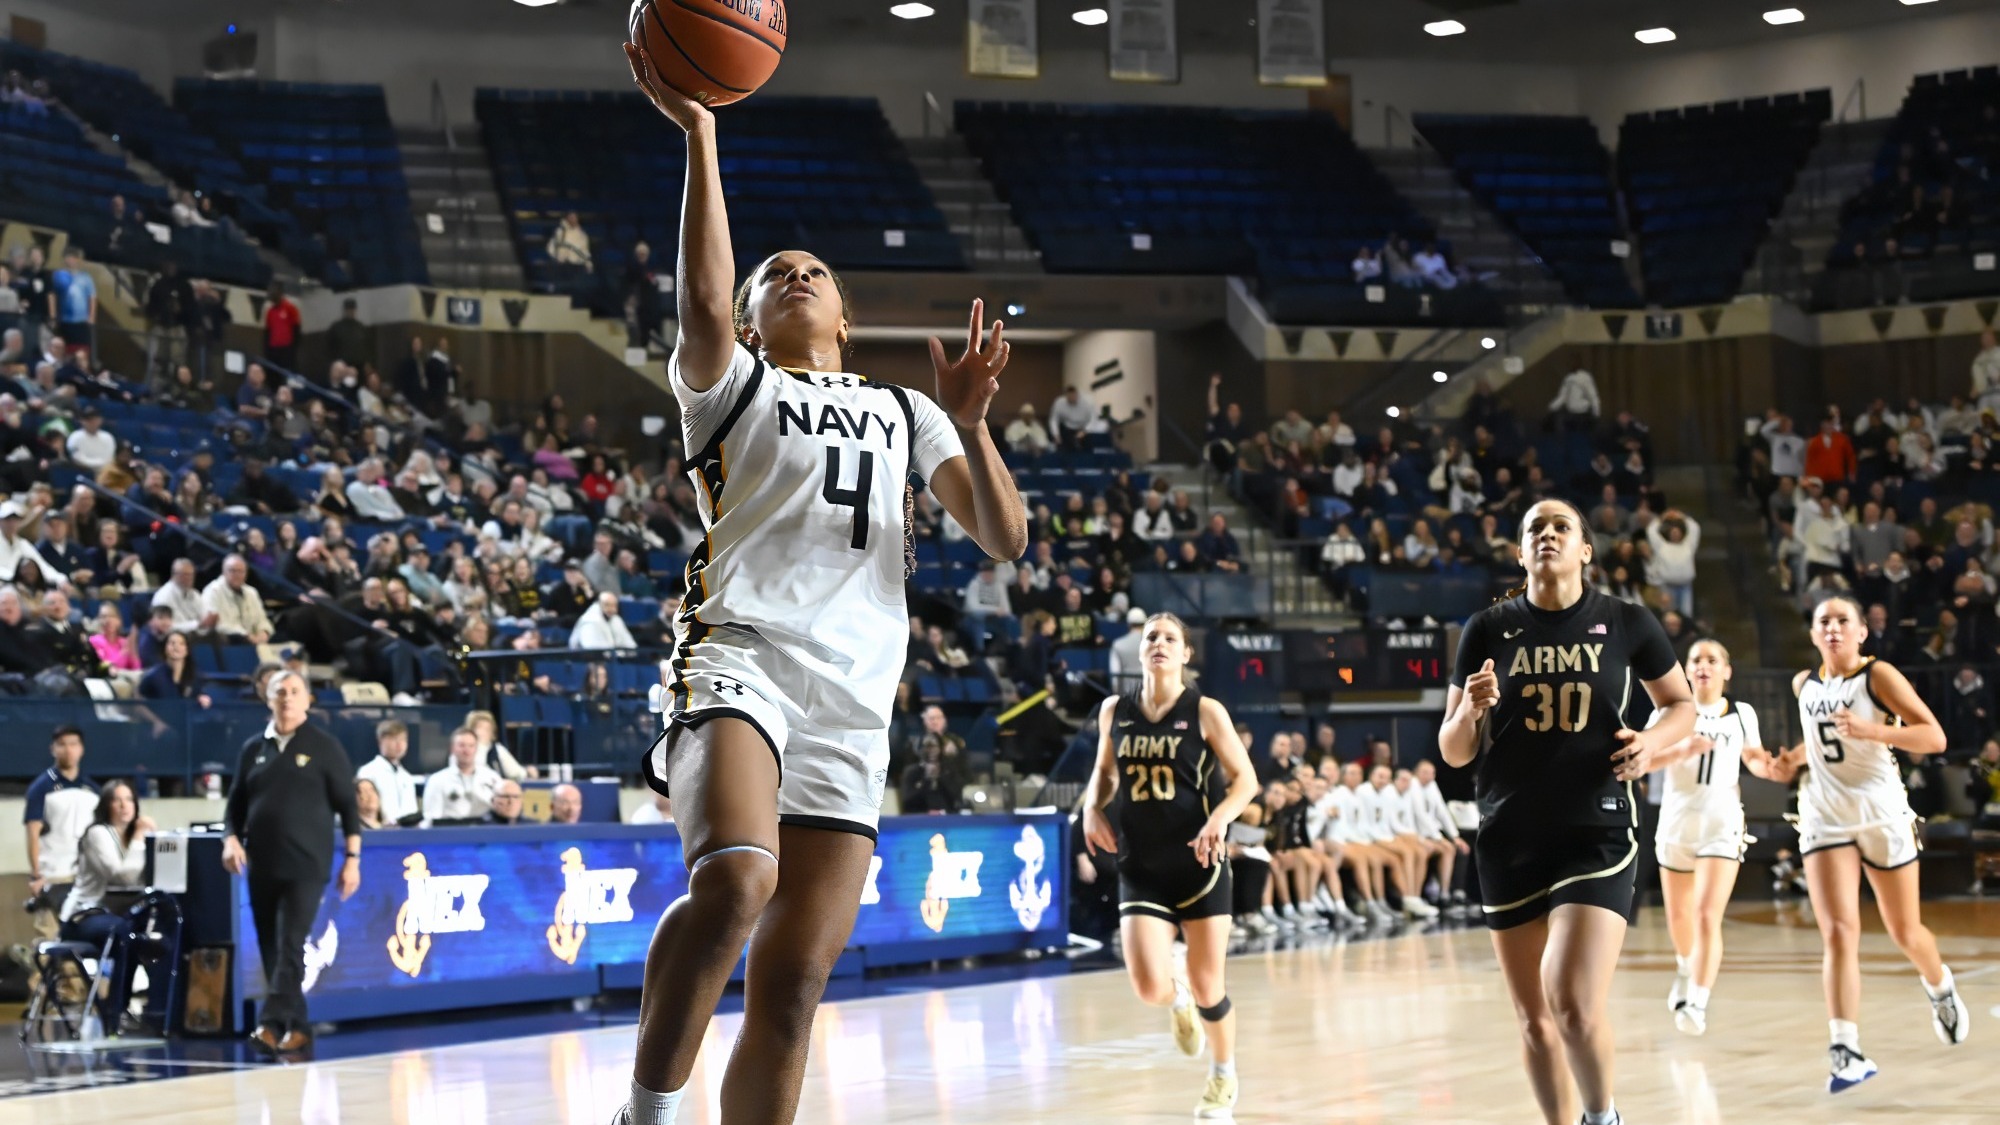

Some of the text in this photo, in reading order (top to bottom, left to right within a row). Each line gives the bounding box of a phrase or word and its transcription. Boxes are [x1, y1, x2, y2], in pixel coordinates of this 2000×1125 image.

[777, 400, 896, 449] NAVY
[823, 445, 874, 550] 4
[1227, 634, 1275, 650] NAVY
[1386, 632, 1434, 649] ARMY
[1407, 658, 1438, 679] 41
[1508, 643, 1604, 677] ARMY
[1521, 681, 1592, 733] 30
[1805, 699, 1854, 717] NAVY
[1118, 734, 1183, 760] ARMY
[1818, 721, 1844, 764] 5
[1126, 764, 1176, 802] 20
[1697, 748, 1715, 785] 11
[404, 874, 489, 935] NEX
[561, 868, 638, 925] NEX
